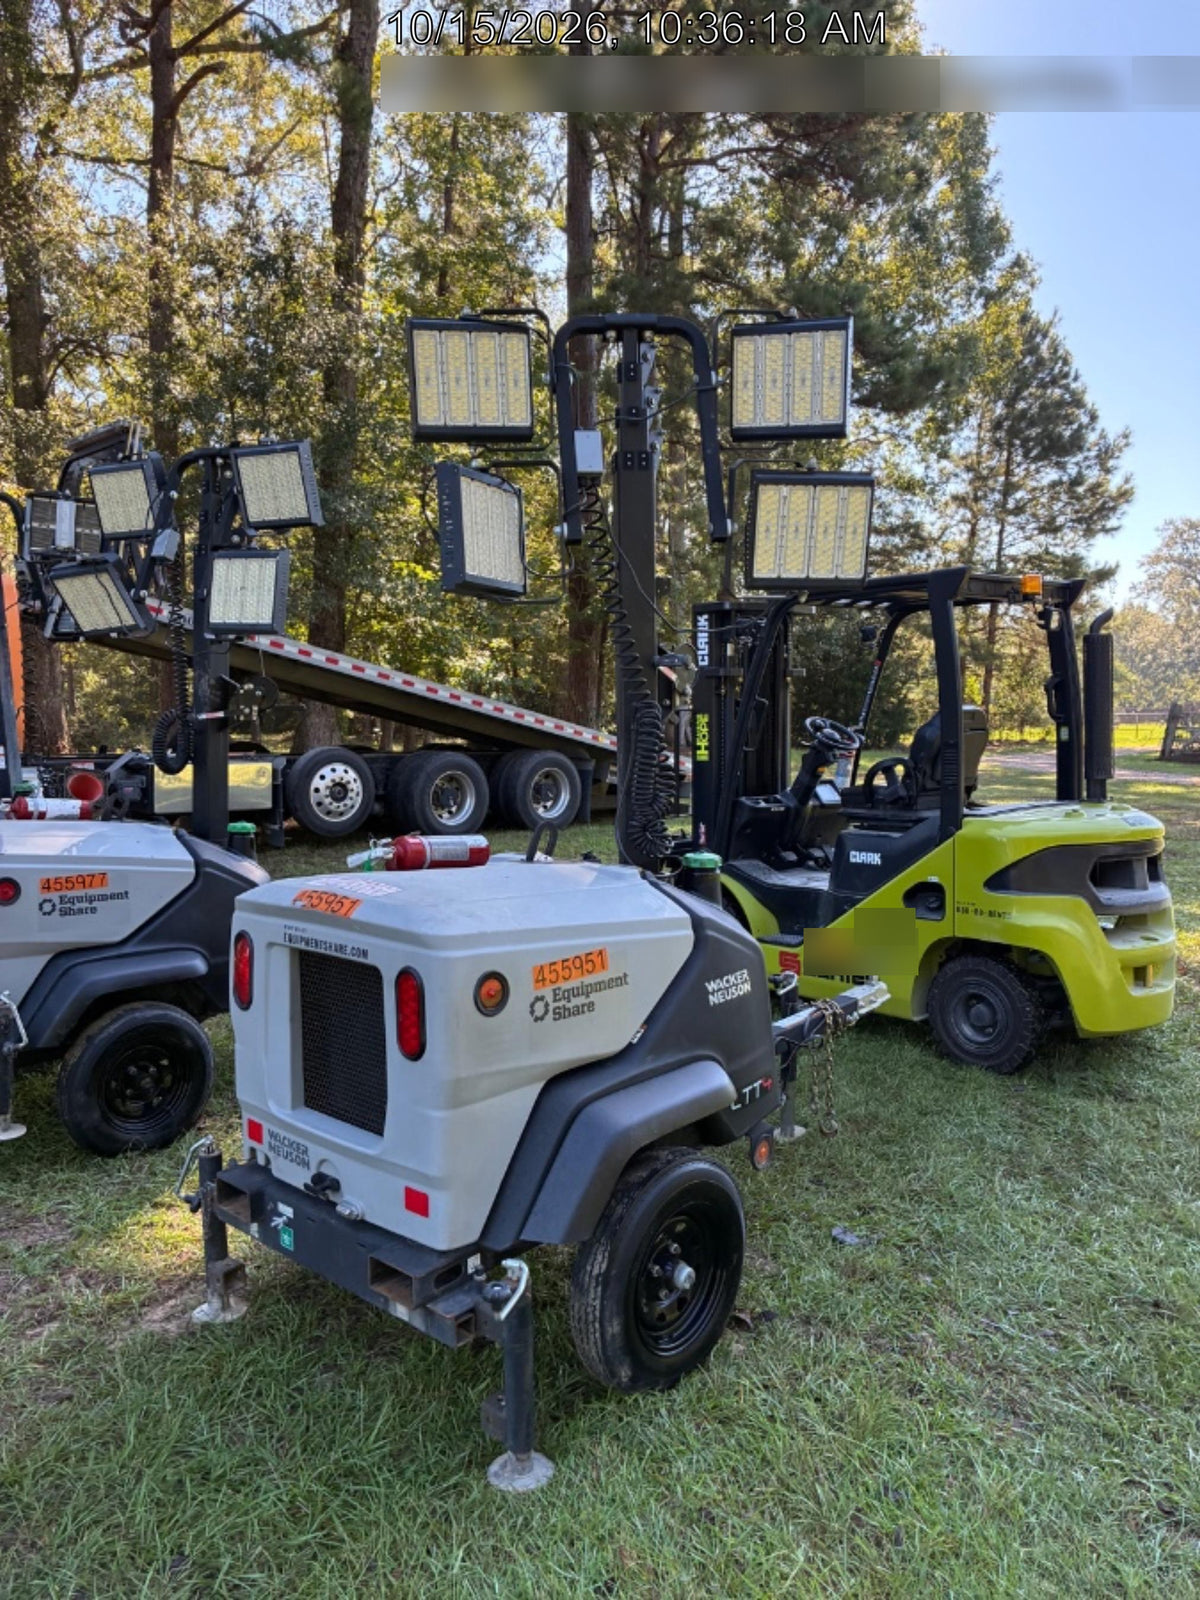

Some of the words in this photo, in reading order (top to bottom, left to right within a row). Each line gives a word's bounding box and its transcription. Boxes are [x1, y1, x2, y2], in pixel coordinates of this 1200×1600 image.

[697, 614, 709, 666] CLARK
[850, 851, 881, 865] CLARK
[41, 872, 107, 893] 455977
[58, 890, 129, 905] Equipment
[58, 906, 98, 917] Share
[534, 949, 606, 987] 455951
[552, 972, 629, 1003] Equipment
[705, 968, 750, 994] WACKER
[708, 982, 752, 1007] NEUSON
[552, 1001, 595, 1022] Share
[267, 1128, 310, 1158] WACKER
[268, 1141, 311, 1171] NEUSON
